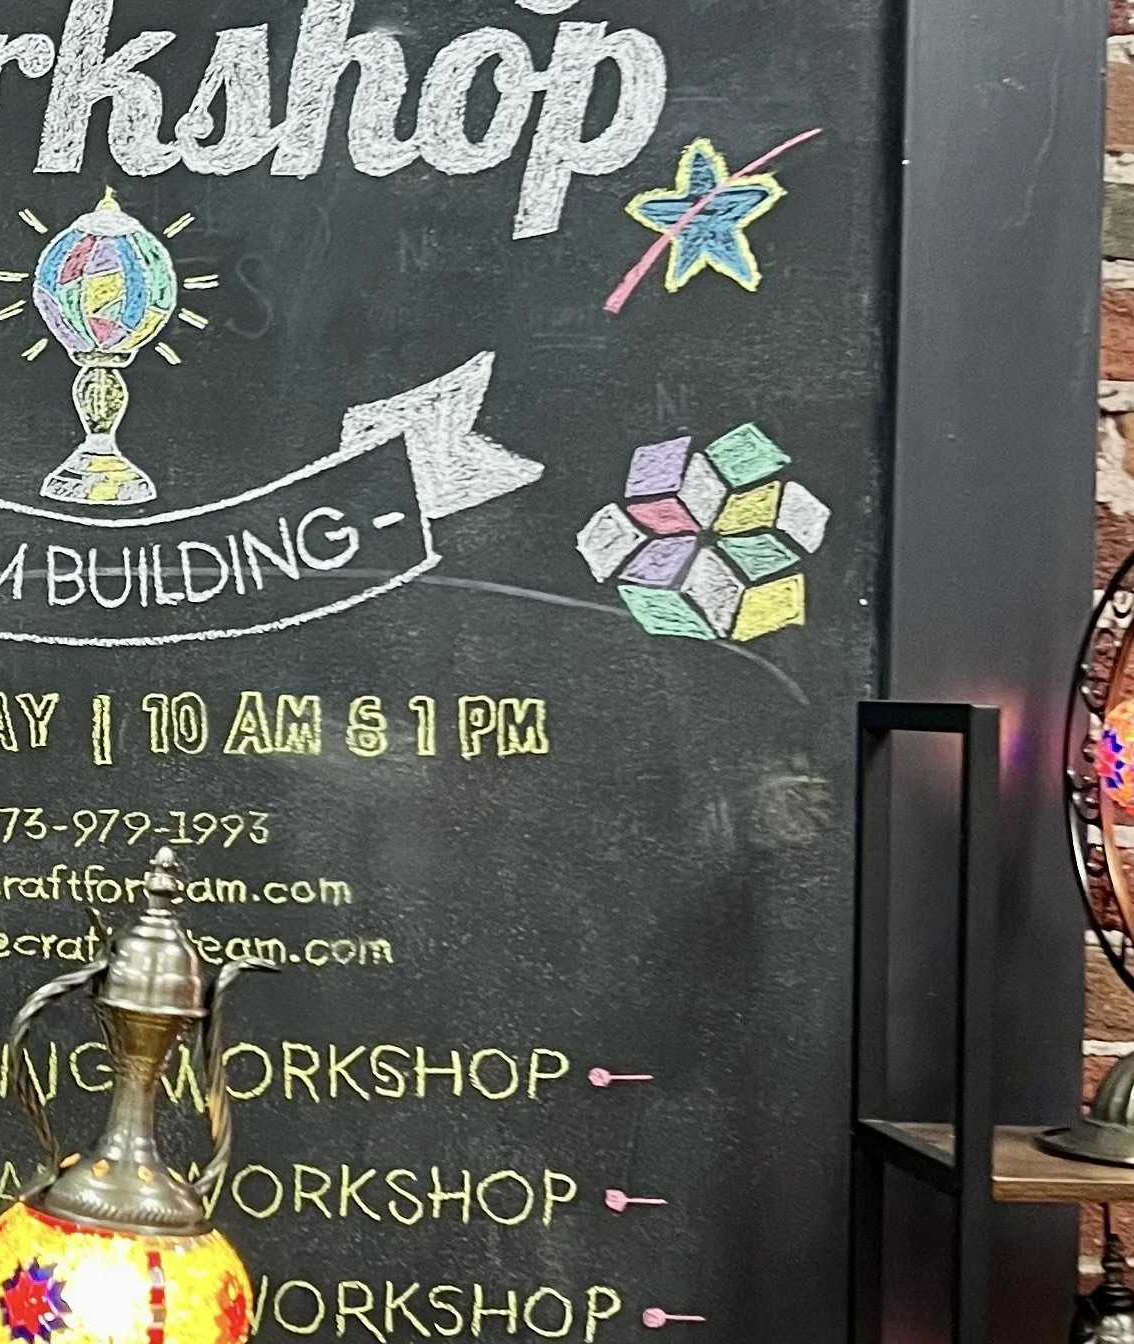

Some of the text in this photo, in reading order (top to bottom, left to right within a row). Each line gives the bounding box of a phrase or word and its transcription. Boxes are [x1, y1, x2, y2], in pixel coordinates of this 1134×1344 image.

[46, 505, 361, 609] BUILDING
[141, 690, 209, 755] 10
[222, 690, 323, 755] AM
[407, 694, 437, 757] 1
[458, 694, 551, 762] PM
